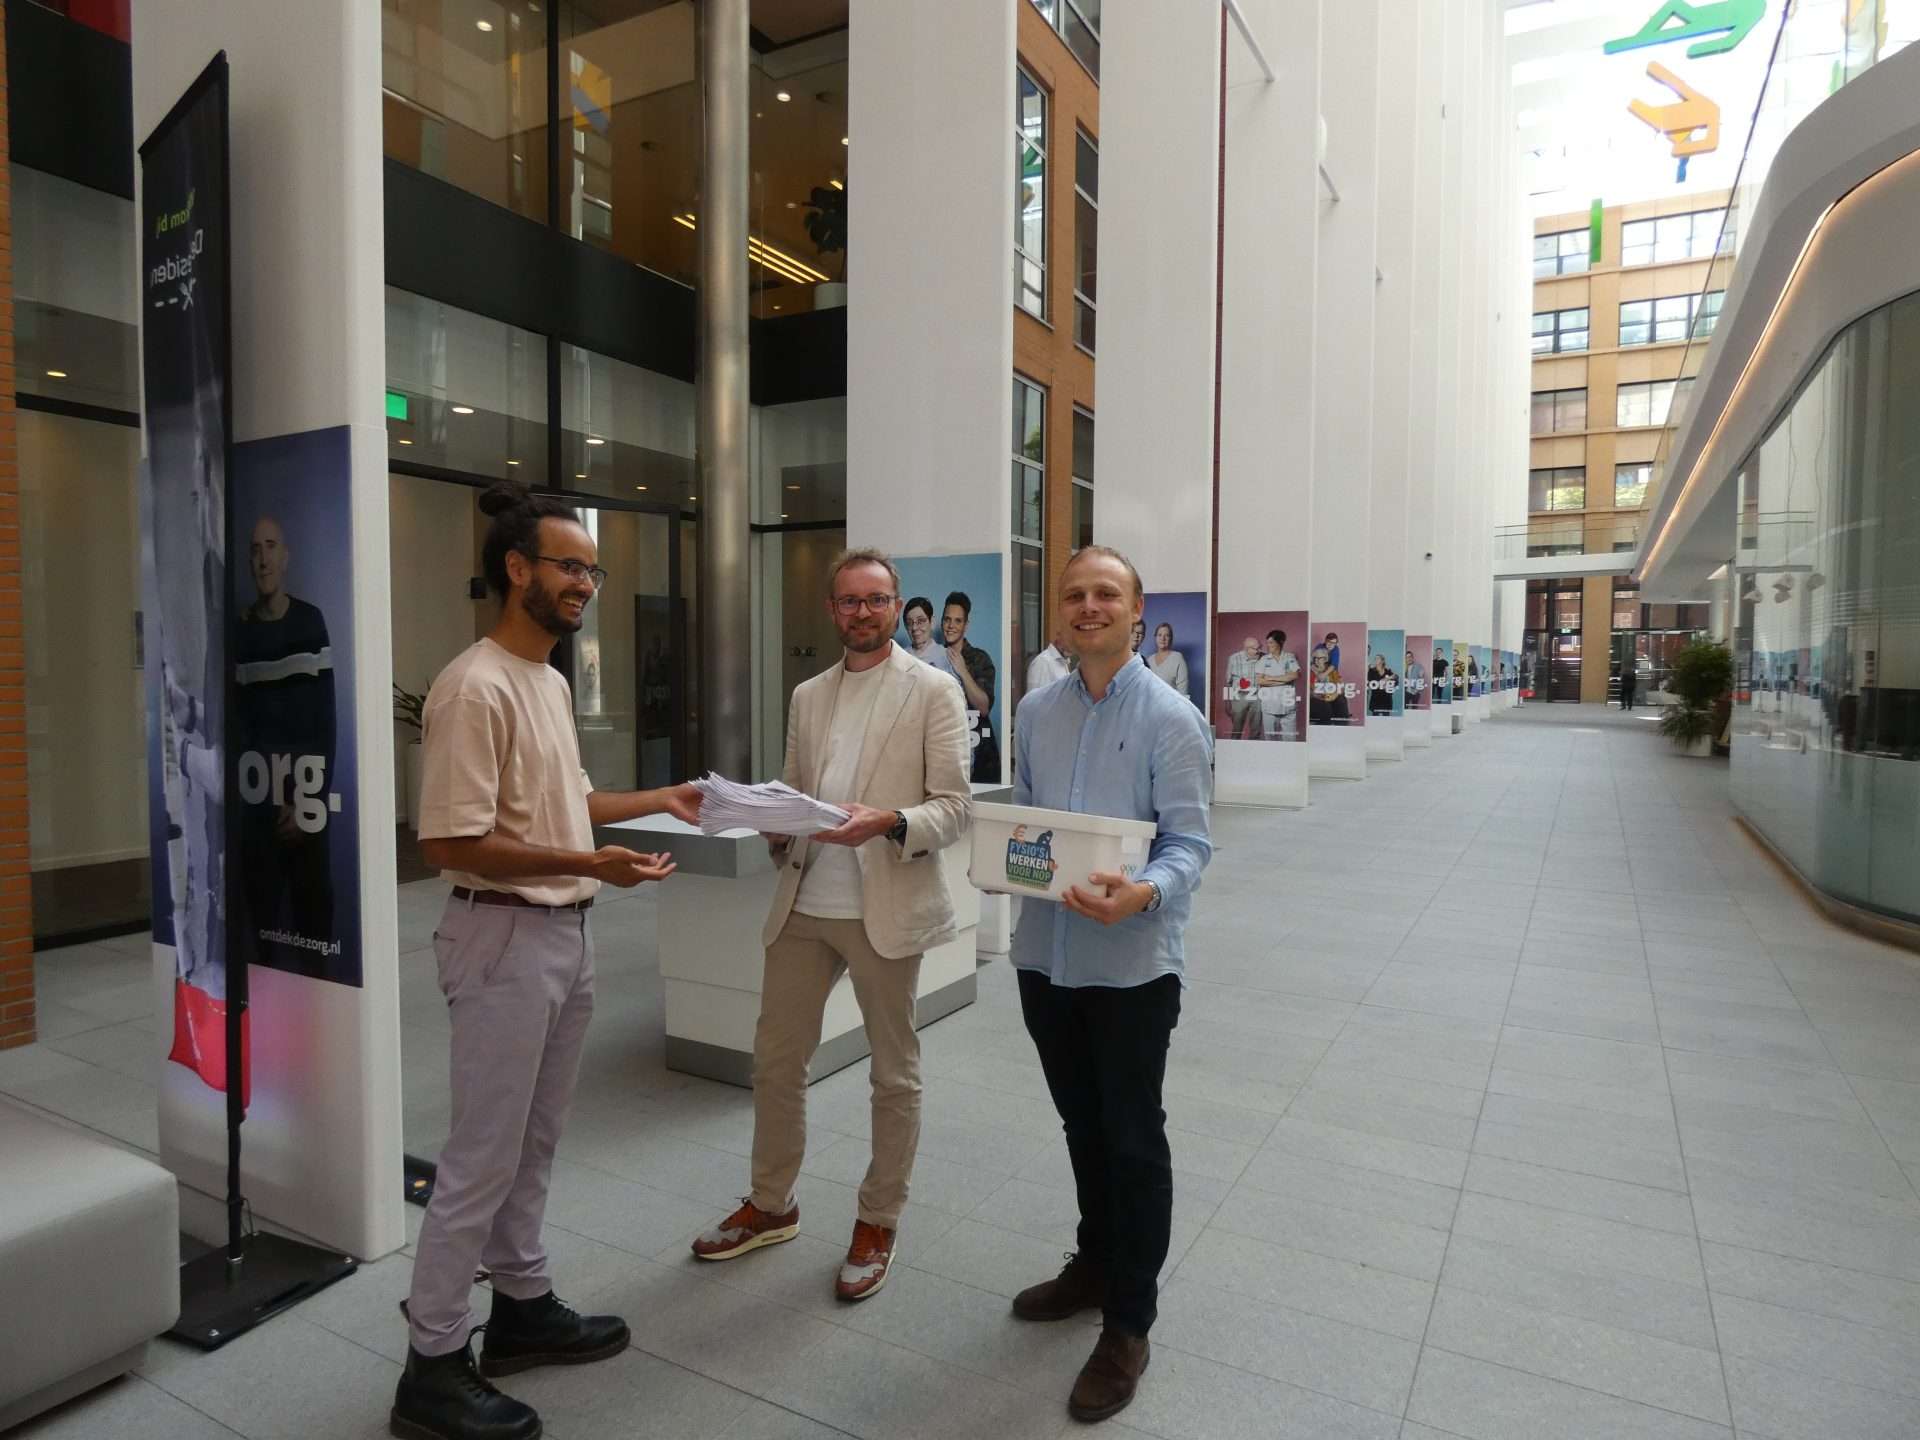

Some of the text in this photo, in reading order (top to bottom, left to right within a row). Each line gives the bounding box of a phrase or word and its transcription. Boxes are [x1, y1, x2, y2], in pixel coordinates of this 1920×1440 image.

[1313, 682, 1361, 698] zorg.
[1367, 680, 1399, 694] org.
[1403, 677, 1428, 690] org.
[238, 750, 342, 833] org.
[1009, 852, 1049, 871] WERKEN
[1008, 863, 1031, 878] VOOR
[258, 927, 342, 956] ontdekdezorg.nl
